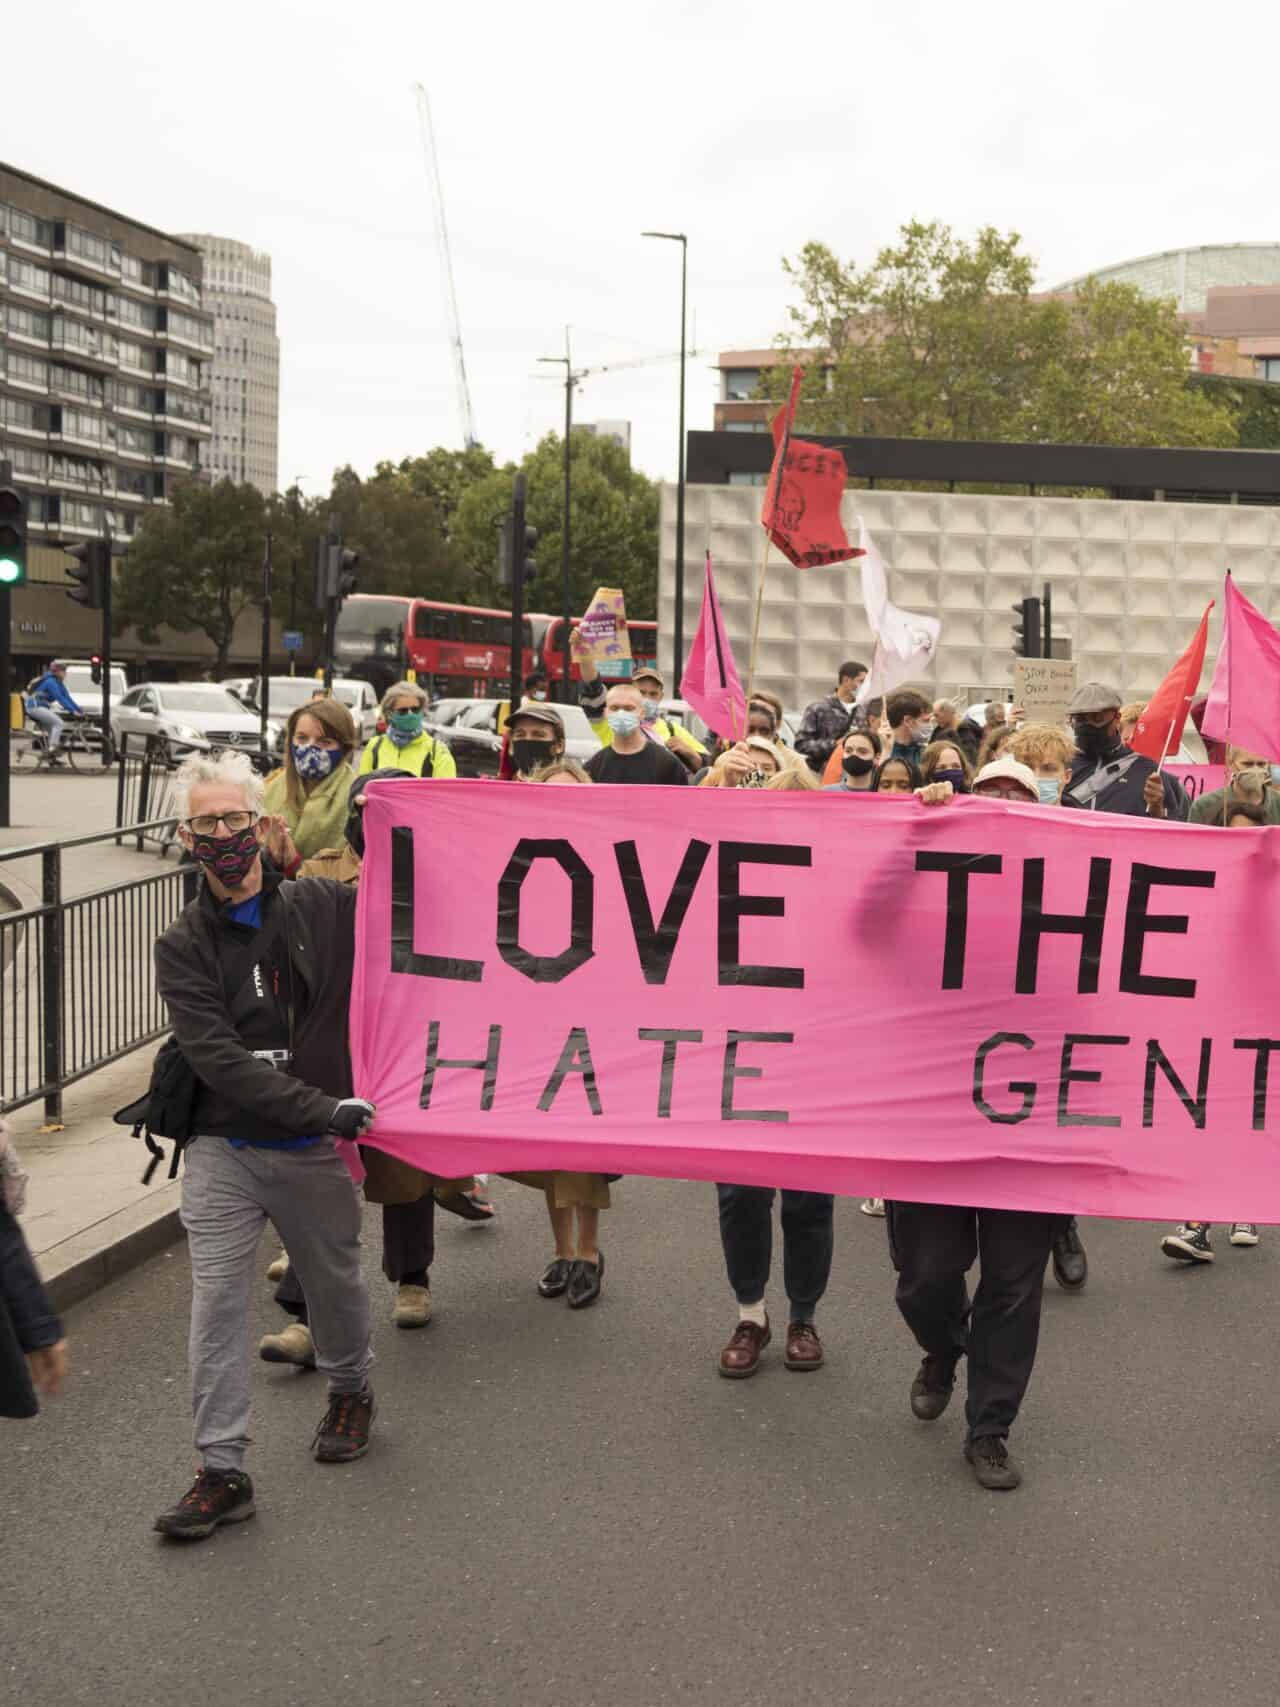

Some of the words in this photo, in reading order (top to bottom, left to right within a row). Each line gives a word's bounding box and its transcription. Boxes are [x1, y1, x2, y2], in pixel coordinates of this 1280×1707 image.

[391, 827, 812, 989] LOVE
[915, 851, 1216, 999] THE
[418, 1020, 794, 1122] HATE
